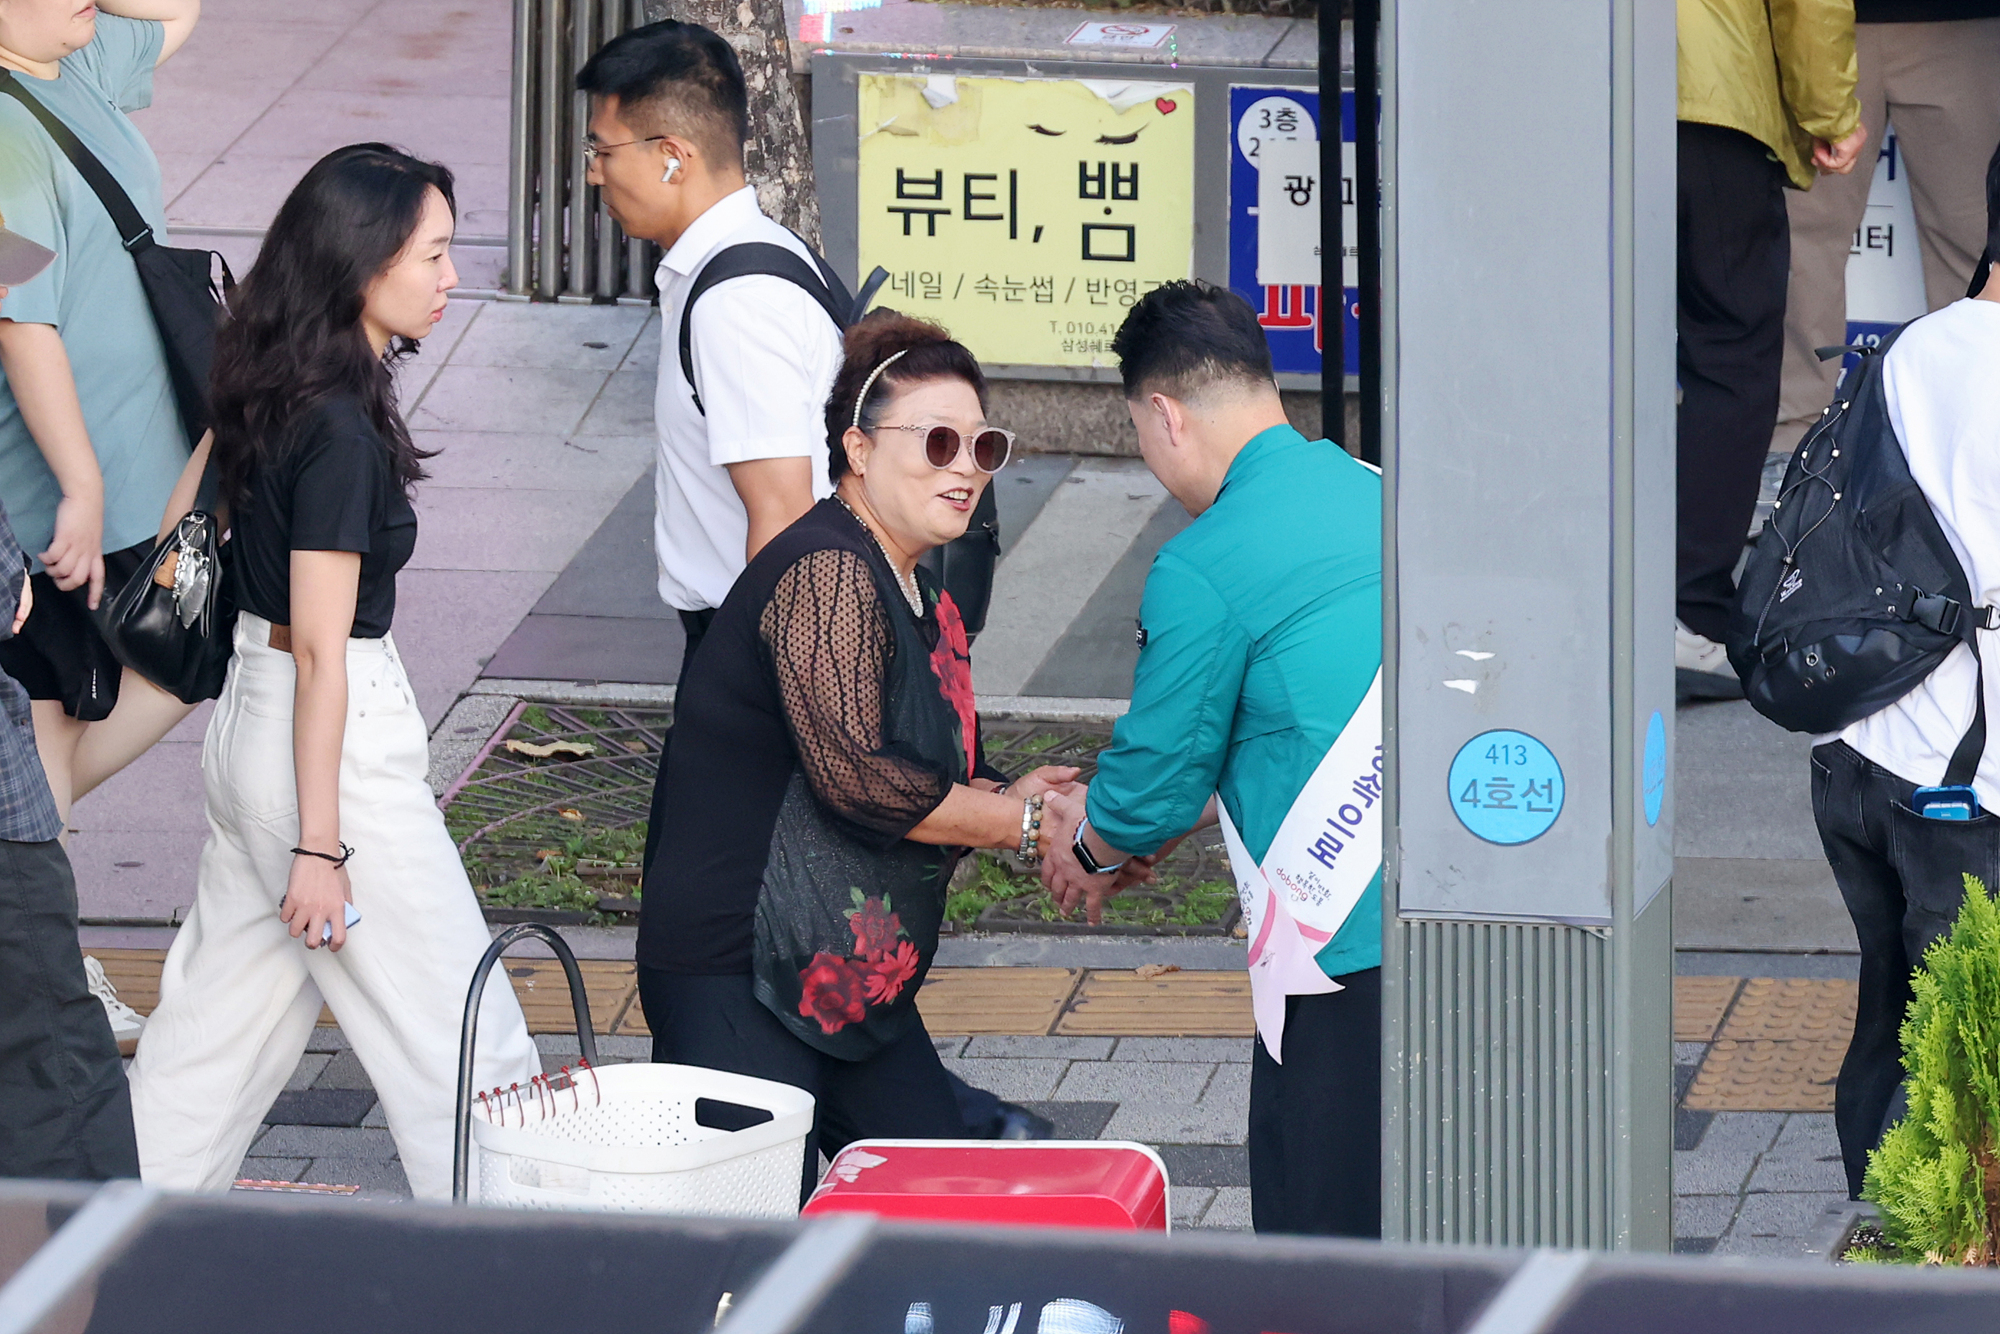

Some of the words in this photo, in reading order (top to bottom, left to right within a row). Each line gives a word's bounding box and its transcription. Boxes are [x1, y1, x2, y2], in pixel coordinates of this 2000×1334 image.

[1259, 107, 1298, 131] 3층
[887, 167, 1044, 243] 뷰티,
[891, 271, 942, 300] 네일
[953, 272, 965, 300] /
[973, 273, 1053, 303] 속눈썹
[1064, 276, 1076, 304] /
[1485, 743, 1528, 766] 413
[1306, 744, 1383, 870] 속으로
[1460, 776, 1554, 813] 4호선
[1275, 867, 1309, 902] dobong
